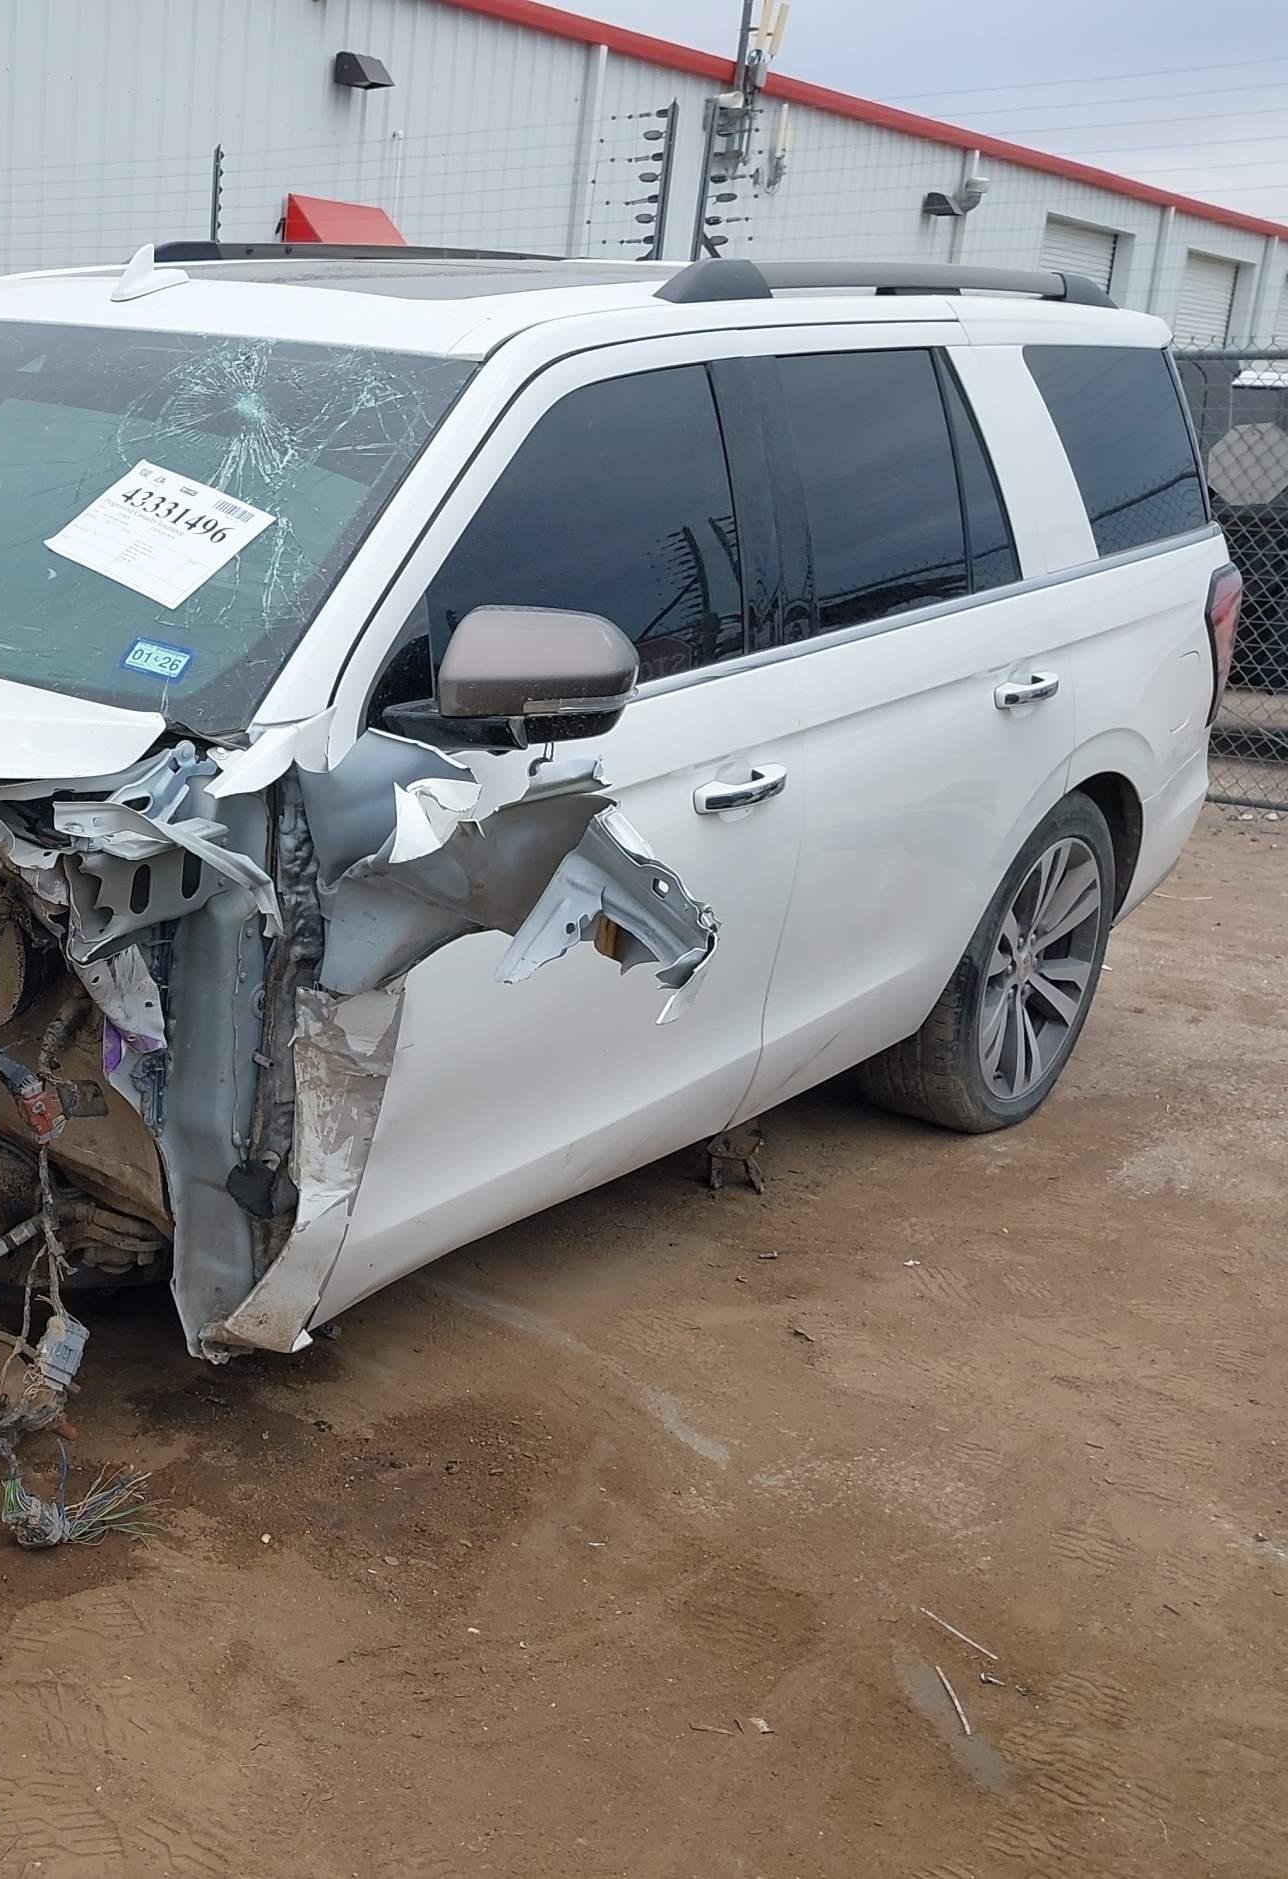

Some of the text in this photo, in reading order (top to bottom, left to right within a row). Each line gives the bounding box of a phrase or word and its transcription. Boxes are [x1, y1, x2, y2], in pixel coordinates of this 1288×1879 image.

[121, 486, 235, 544] 43331496
[132, 648, 182, 671] 01 26
